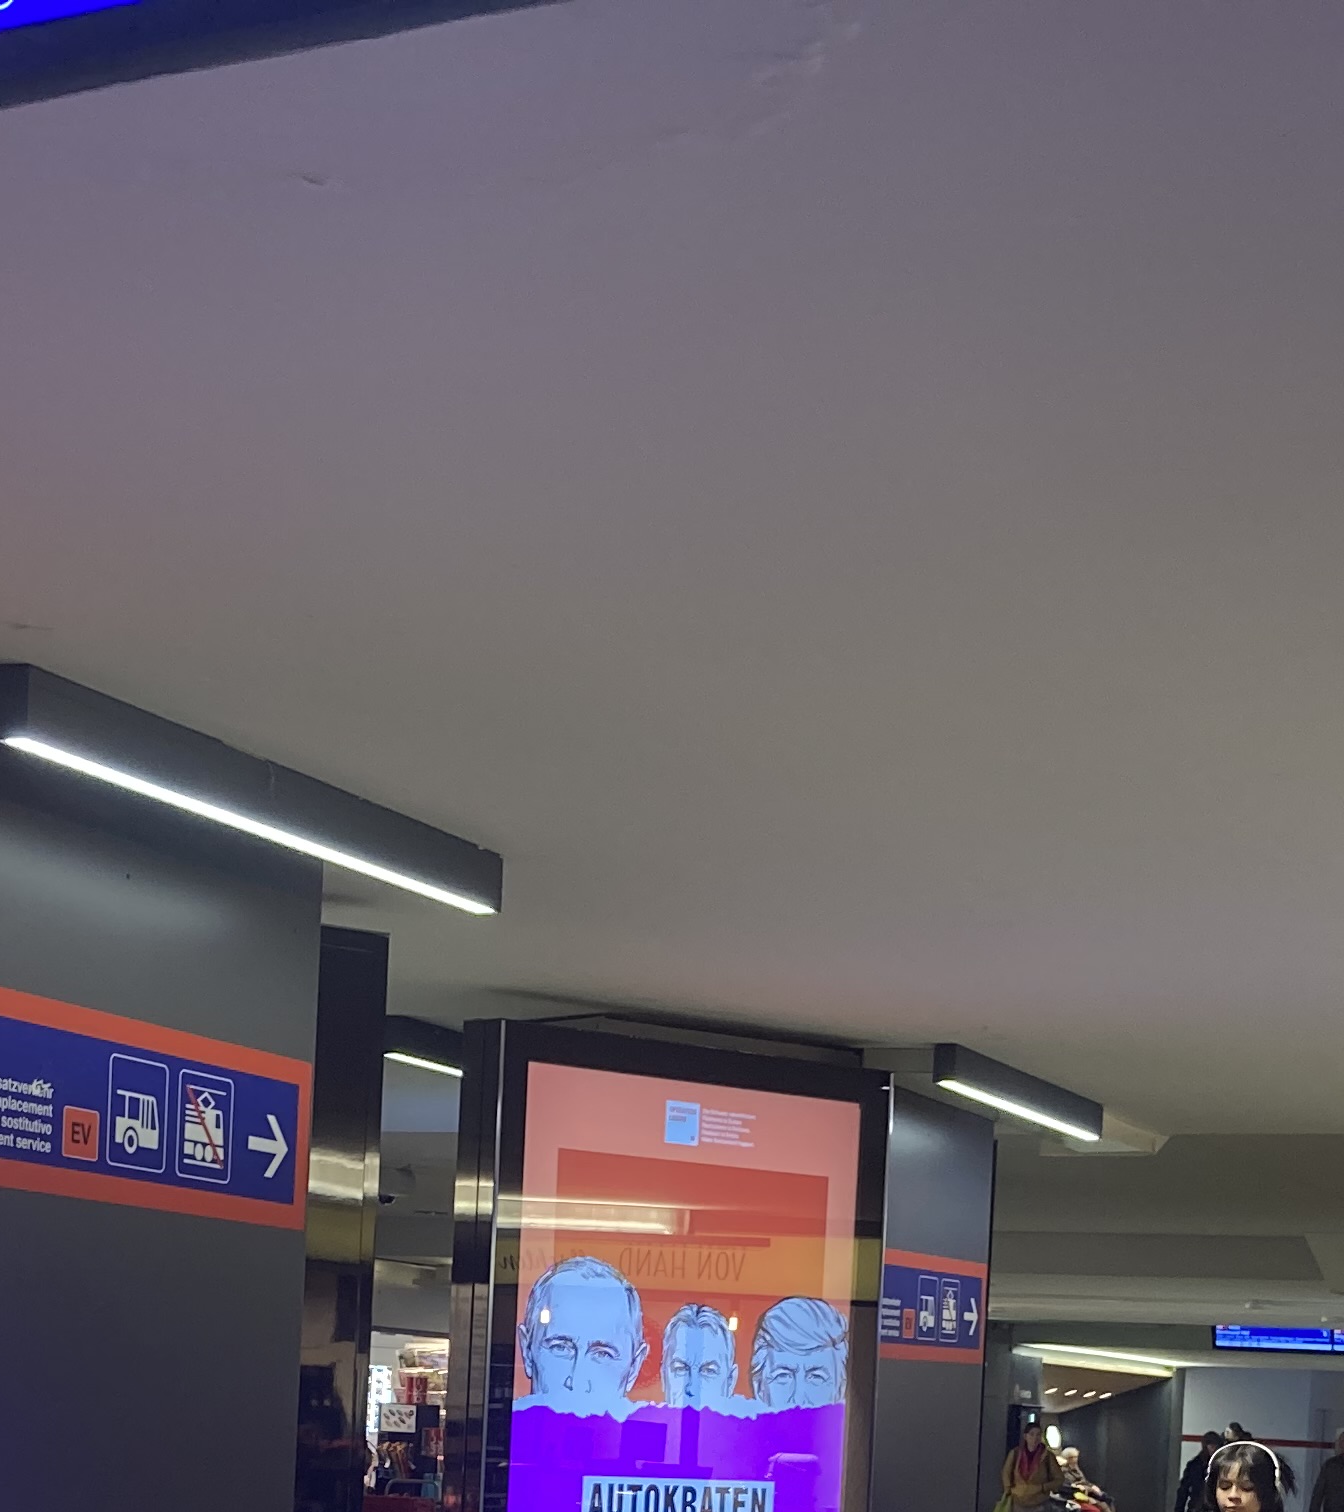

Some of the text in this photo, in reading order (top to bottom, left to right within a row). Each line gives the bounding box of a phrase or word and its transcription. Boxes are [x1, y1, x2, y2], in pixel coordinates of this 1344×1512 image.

[1, 1114, 52, 1135] sostitutivo
[71, 1121, 92, 1145] EV
[15, 1134, 51, 1153] service
